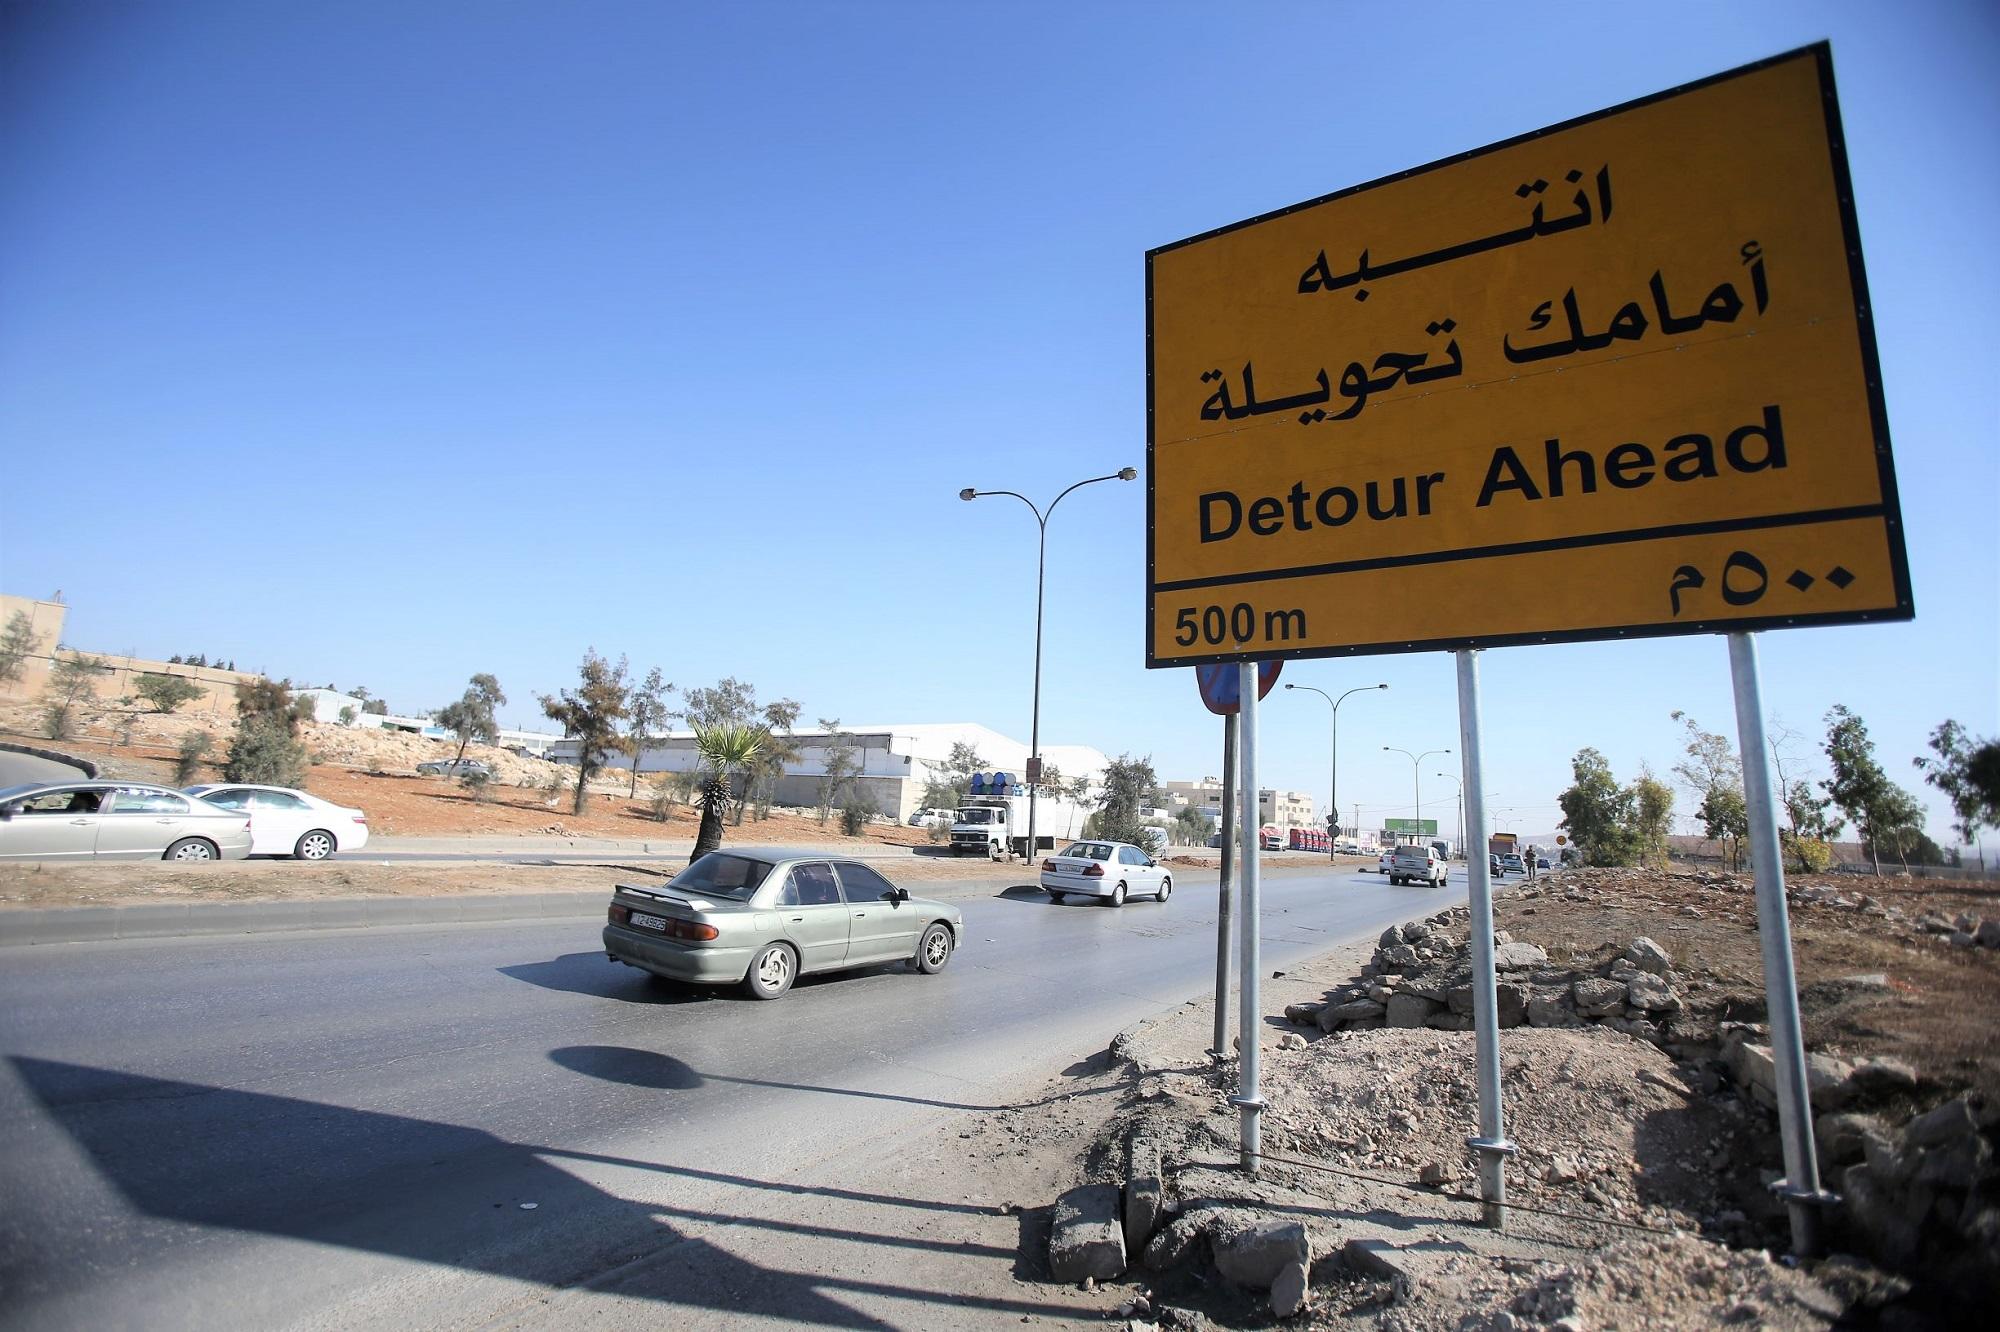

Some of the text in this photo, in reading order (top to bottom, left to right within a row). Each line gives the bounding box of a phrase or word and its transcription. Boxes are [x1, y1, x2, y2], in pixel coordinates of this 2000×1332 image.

[1298, 163, 1613, 302] انتبه
[1200, 240, 1769, 426] أمامك تحويلة
[1199, 405, 1789, 544] Detour Ahead
[1175, 602, 1255, 647] 500
